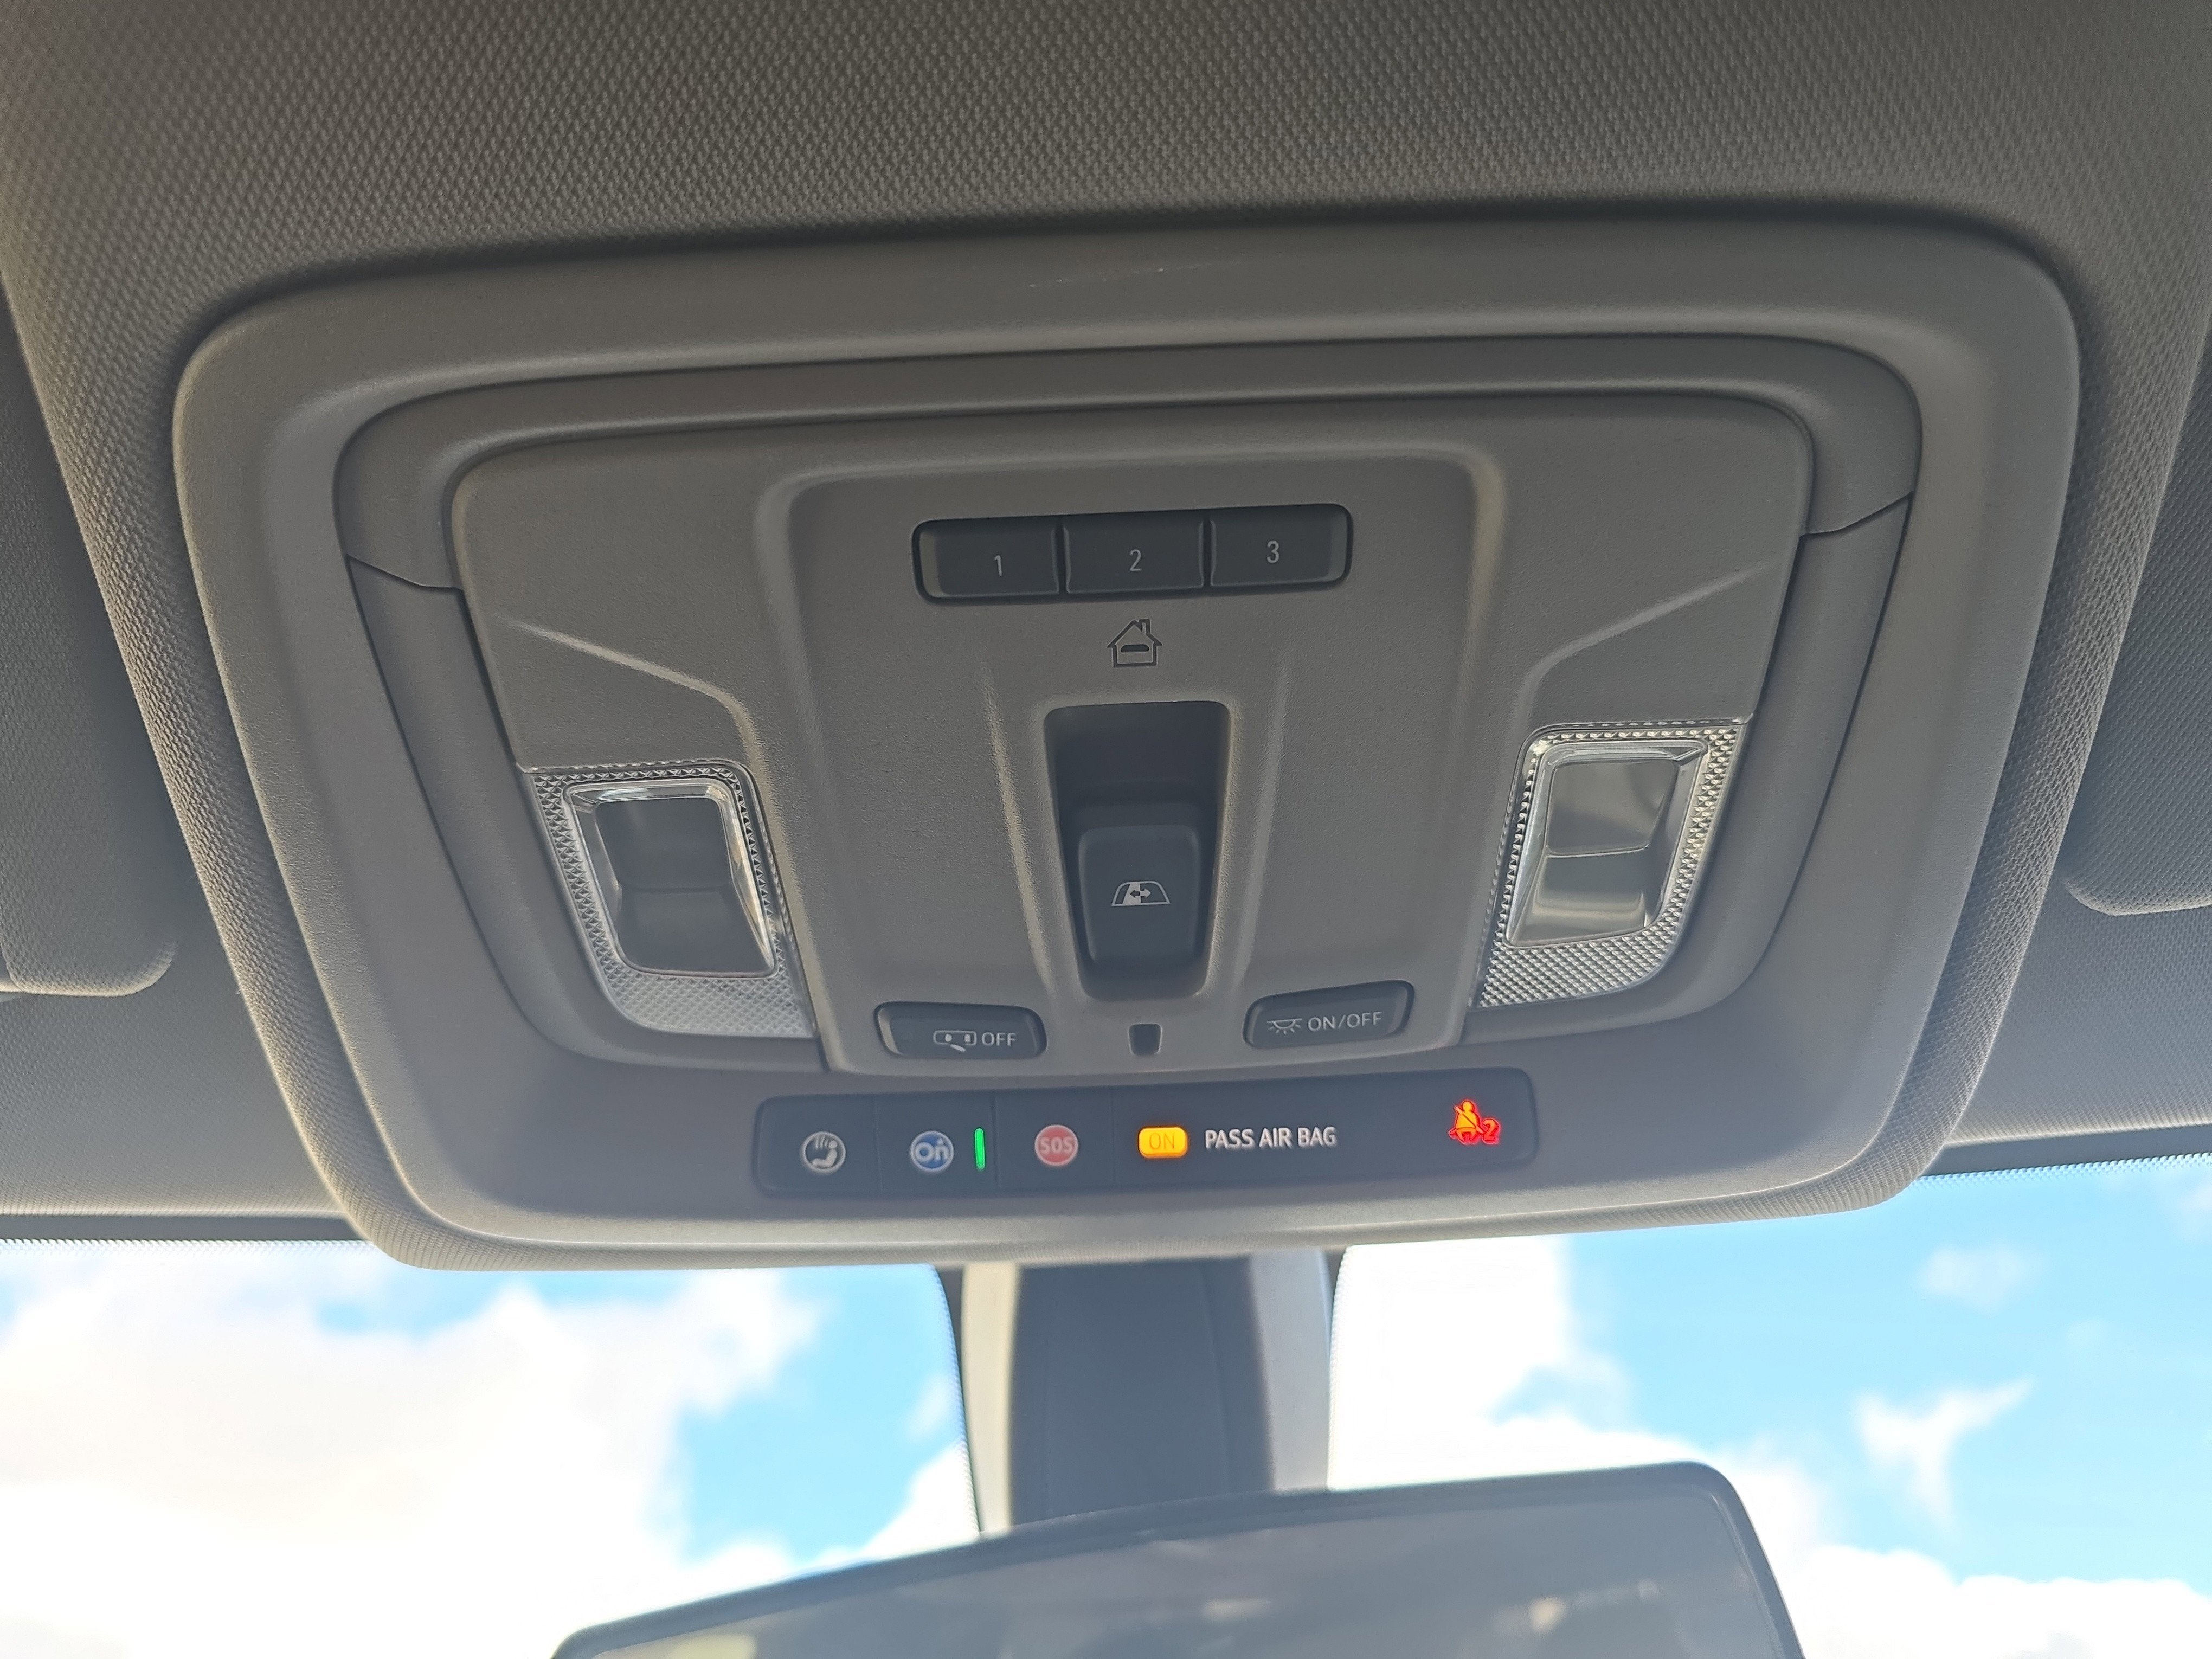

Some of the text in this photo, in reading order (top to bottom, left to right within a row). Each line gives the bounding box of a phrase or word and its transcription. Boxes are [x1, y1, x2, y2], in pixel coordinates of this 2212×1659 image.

[1129, 549, 1142, 571] 2
[1266, 541, 1280, 563] 3
[993, 555, 1004, 576] 1
[1307, 1012, 1382, 1032] ON/OFF
[981, 1032, 1017, 1046] OFF
[1039, 1136, 1074, 1155] SOS
[1149, 1131, 1175, 1150] ON
[1205, 1126, 1336, 1150] PASS AIR BAG
